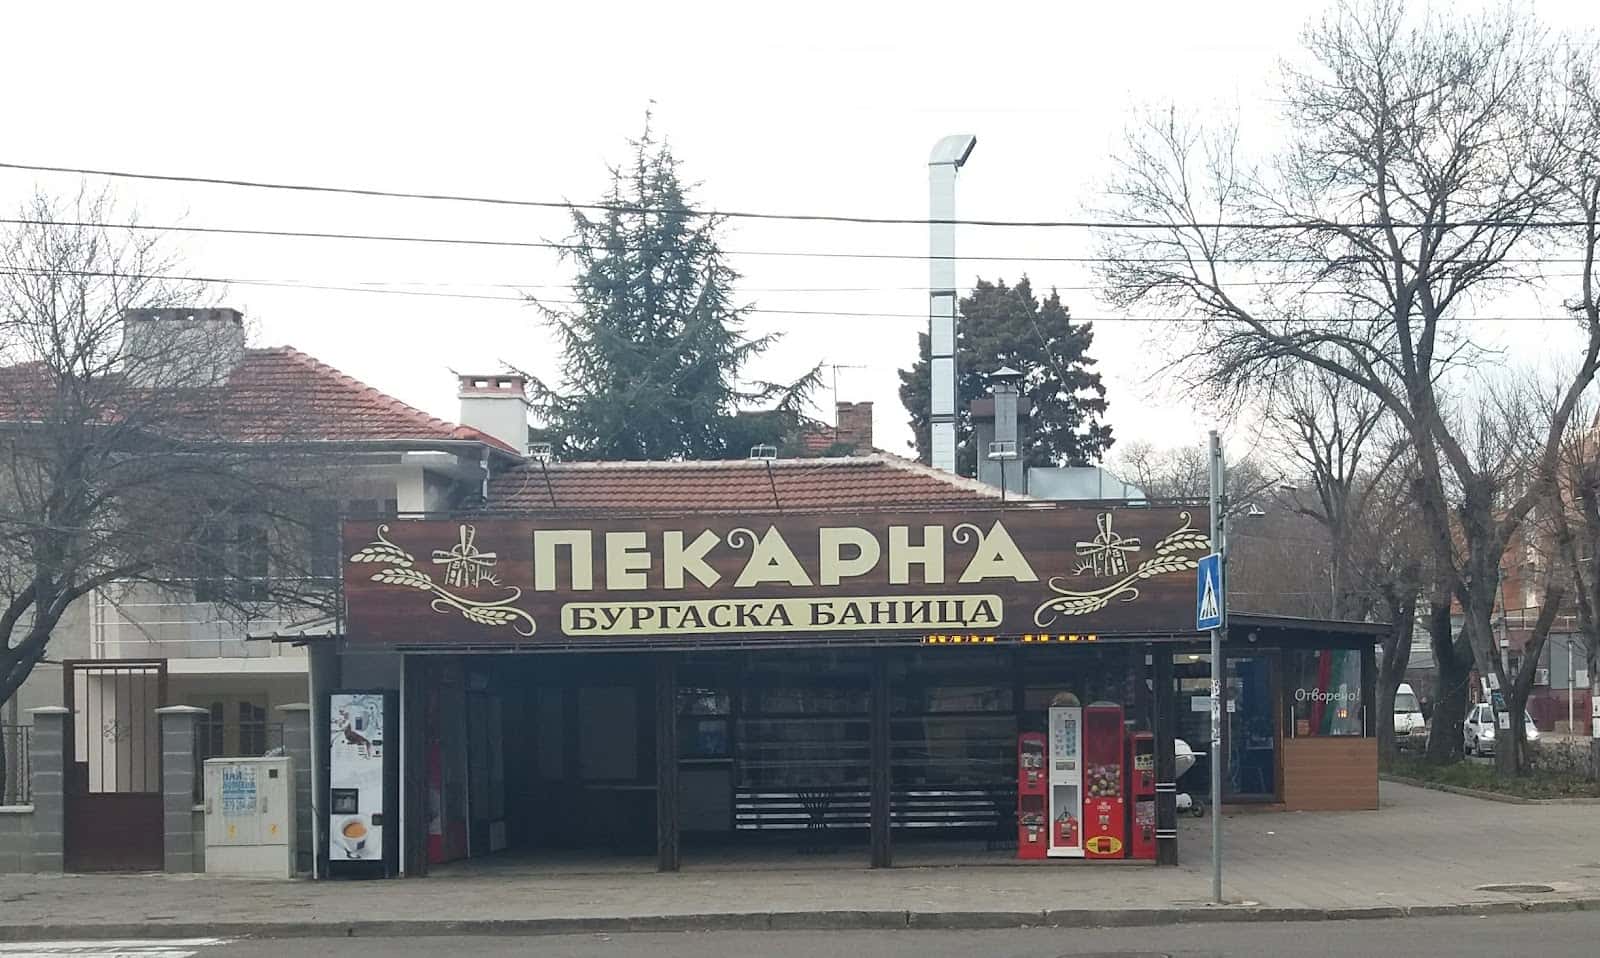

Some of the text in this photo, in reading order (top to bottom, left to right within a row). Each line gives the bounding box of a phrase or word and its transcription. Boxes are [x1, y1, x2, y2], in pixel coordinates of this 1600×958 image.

[534, 520, 1039, 590] ПЕКАРНА
[570, 600, 998, 630] БУРГАСКА БАНИЦА
[1294, 687, 1361, 705] Отворено!
